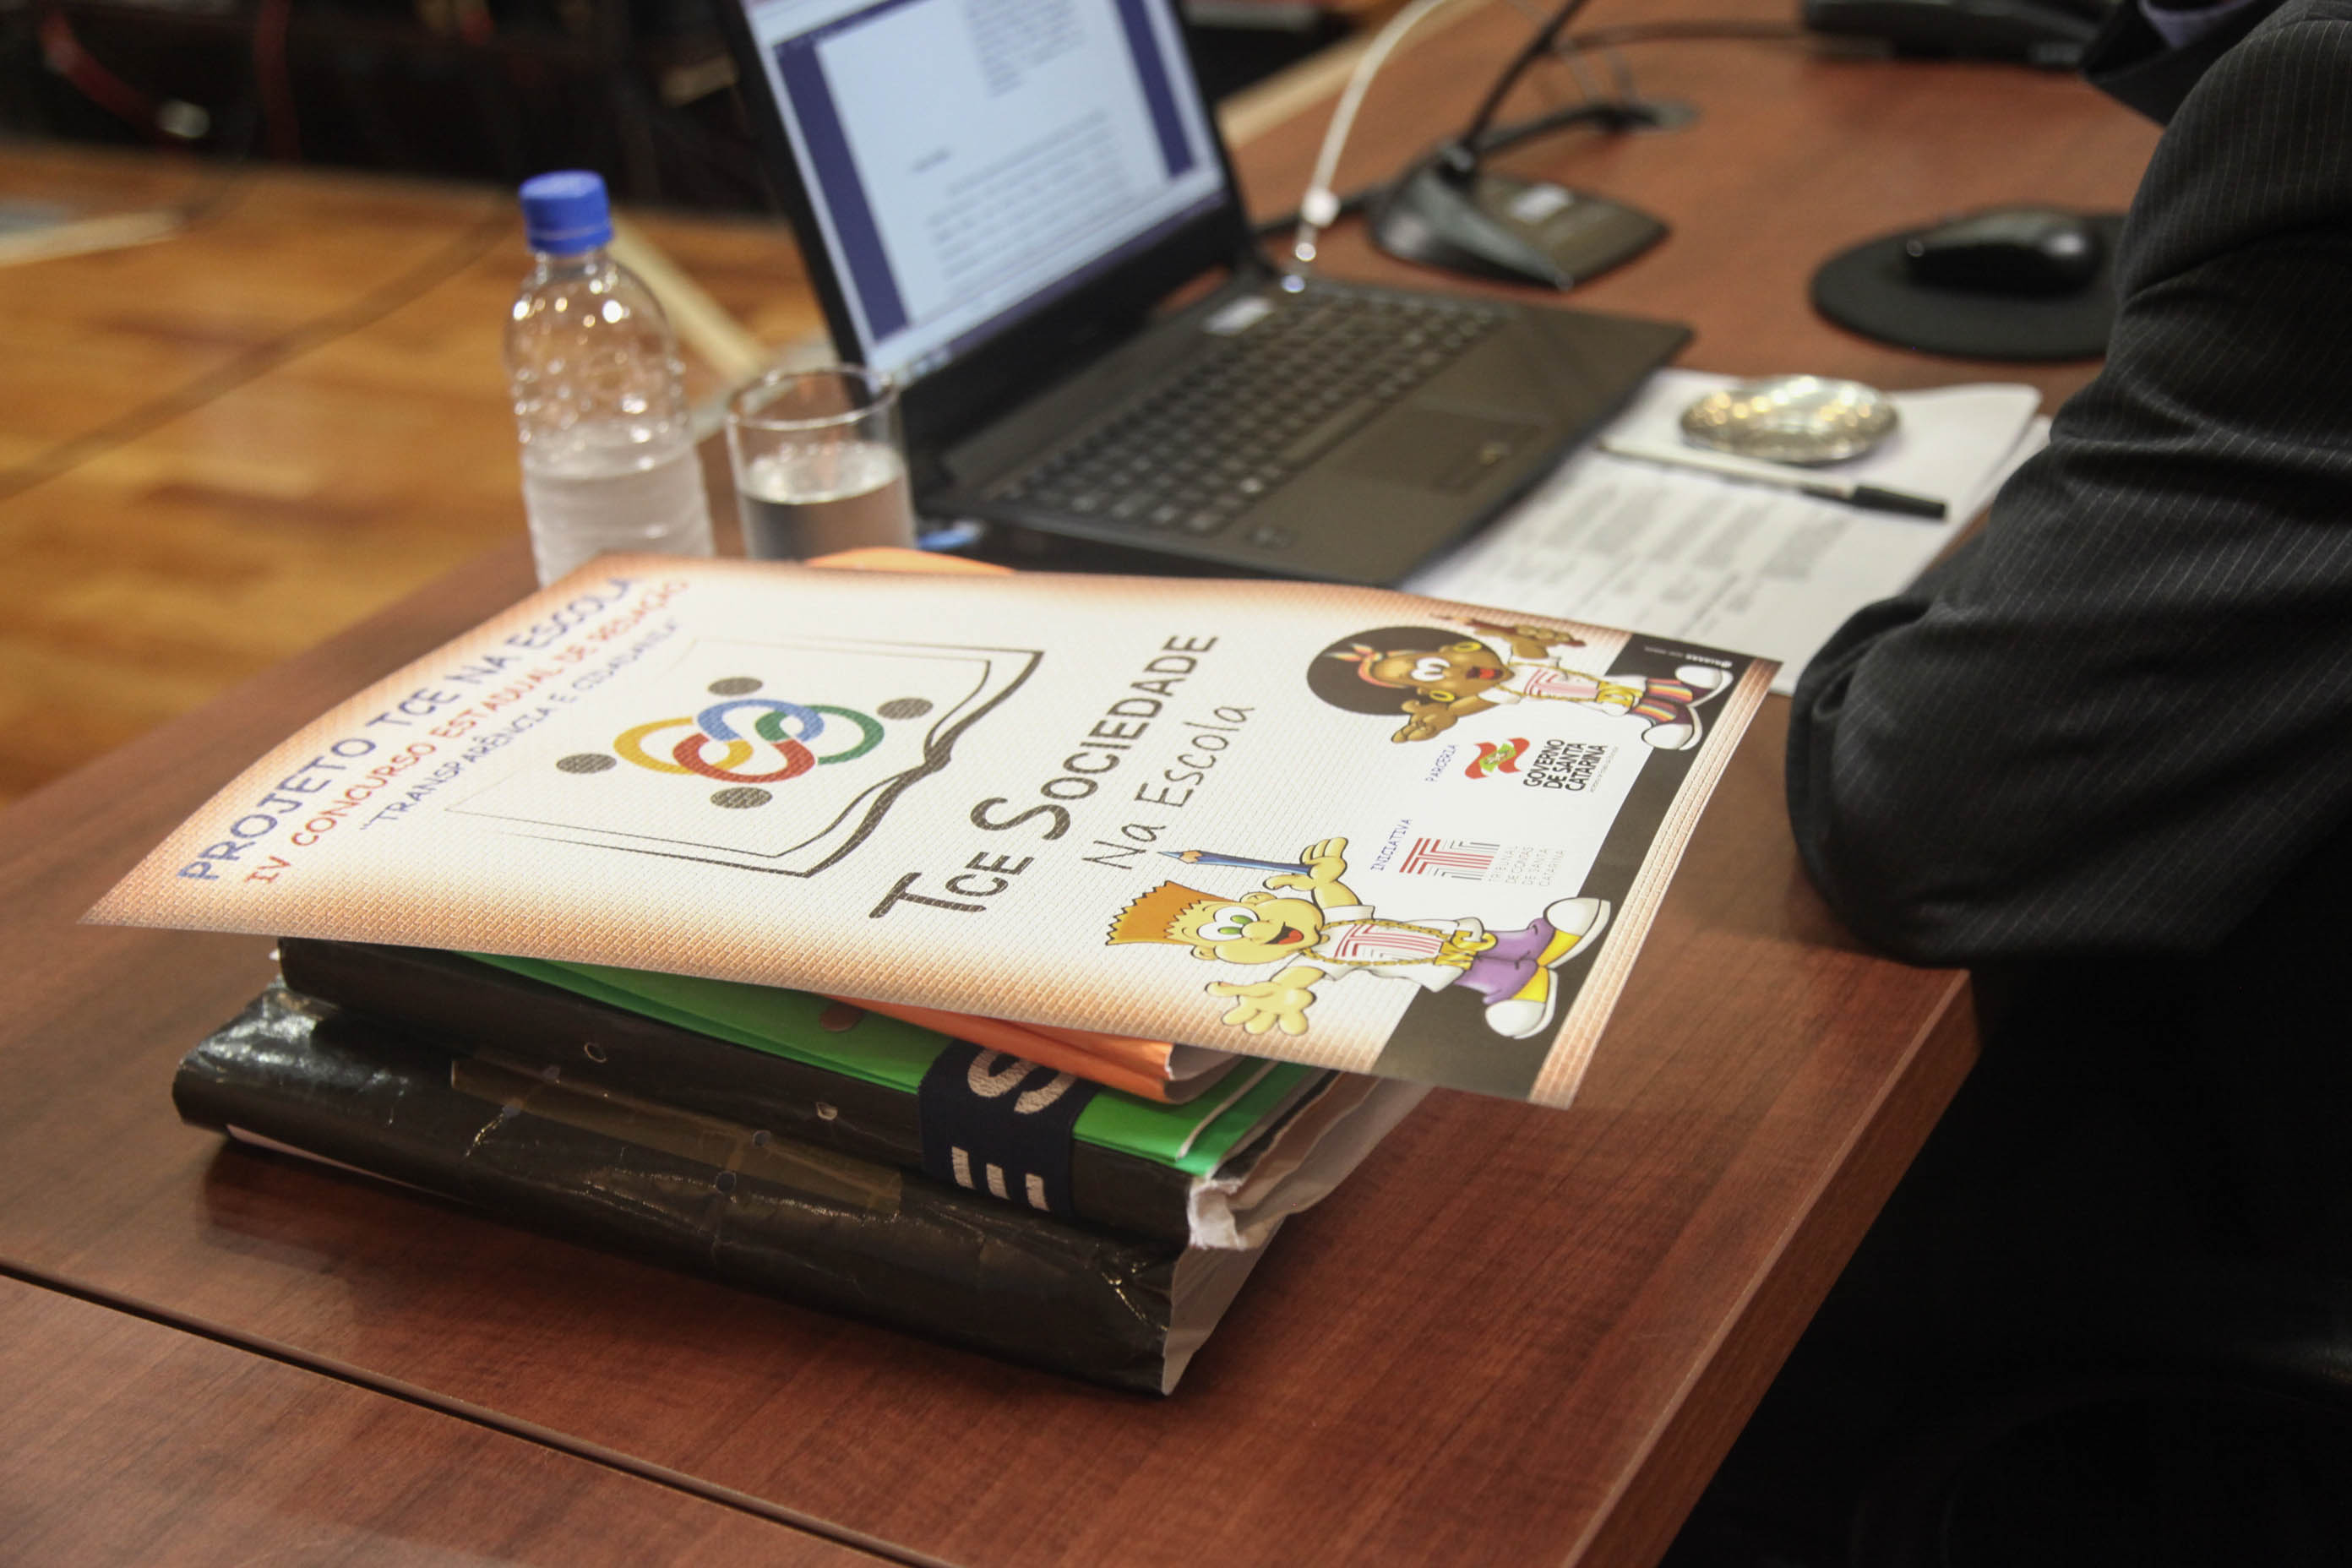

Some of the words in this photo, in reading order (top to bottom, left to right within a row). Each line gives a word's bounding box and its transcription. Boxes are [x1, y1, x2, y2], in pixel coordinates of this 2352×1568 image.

[176, 738, 377, 880] PROJETO
[365, 688, 461, 727] TCE
[443, 655, 521, 685] NA
[1523, 739, 1565, 787] GOVERNO
[1543, 775, 1568, 789] DE
[1552, 743, 1587, 773] SANTA
[1565, 745, 1609, 791] CATARINA
[244, 855, 291, 883] IV
[291, 743, 436, 847] CONCURSO
[1081, 820, 1167, 870] Na
[1370, 817, 1413, 871] INICIATIVA
